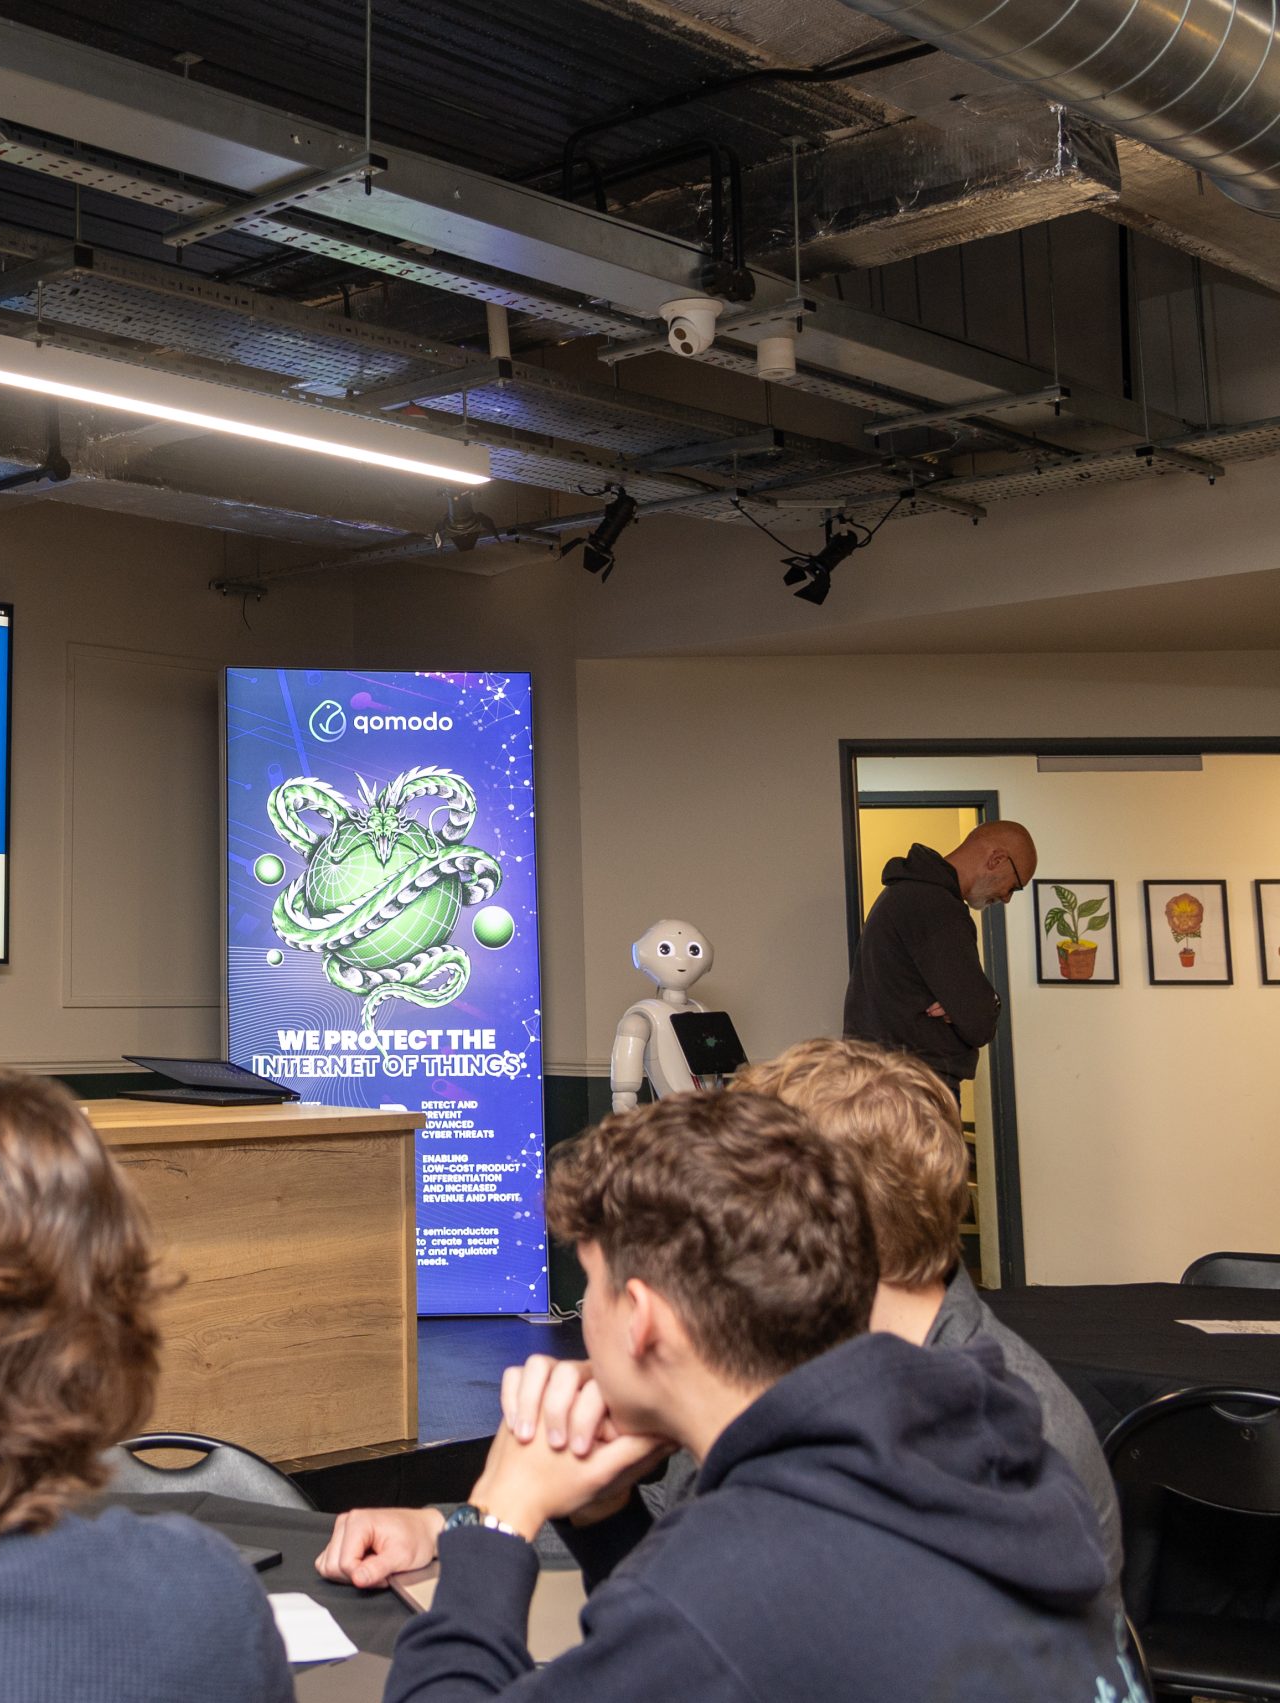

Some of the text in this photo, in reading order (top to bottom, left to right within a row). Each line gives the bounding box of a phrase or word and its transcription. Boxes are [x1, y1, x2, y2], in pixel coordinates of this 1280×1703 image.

[353, 711, 453, 734] qomodo
[277, 1029, 496, 1051] WE PROTECT THE
[252, 1053, 521, 1078] INTERNET OF THINGS
[421, 1100, 478, 1109] DETECT AND
[421, 1129, 494, 1139] CYBER THREATS
[422, 1154, 469, 1163] ENABLING
[422, 1163, 520, 1173] LOW-COST PRODUCT
[422, 1174, 502, 1183] DIFFERENTIATION
[422, 1183, 497, 1193] AND INCREASED
[423, 1194, 465, 1203] REVENUE
[465, 1193, 486, 1202] AND
[423, 1226, 499, 1236] semiconductors
[416, 1237, 499, 1246] to create secure
[428, 1246, 447, 1256] and
[449, 1245, 500, 1258] regulators'
[417, 1257, 449, 1266] needs.
